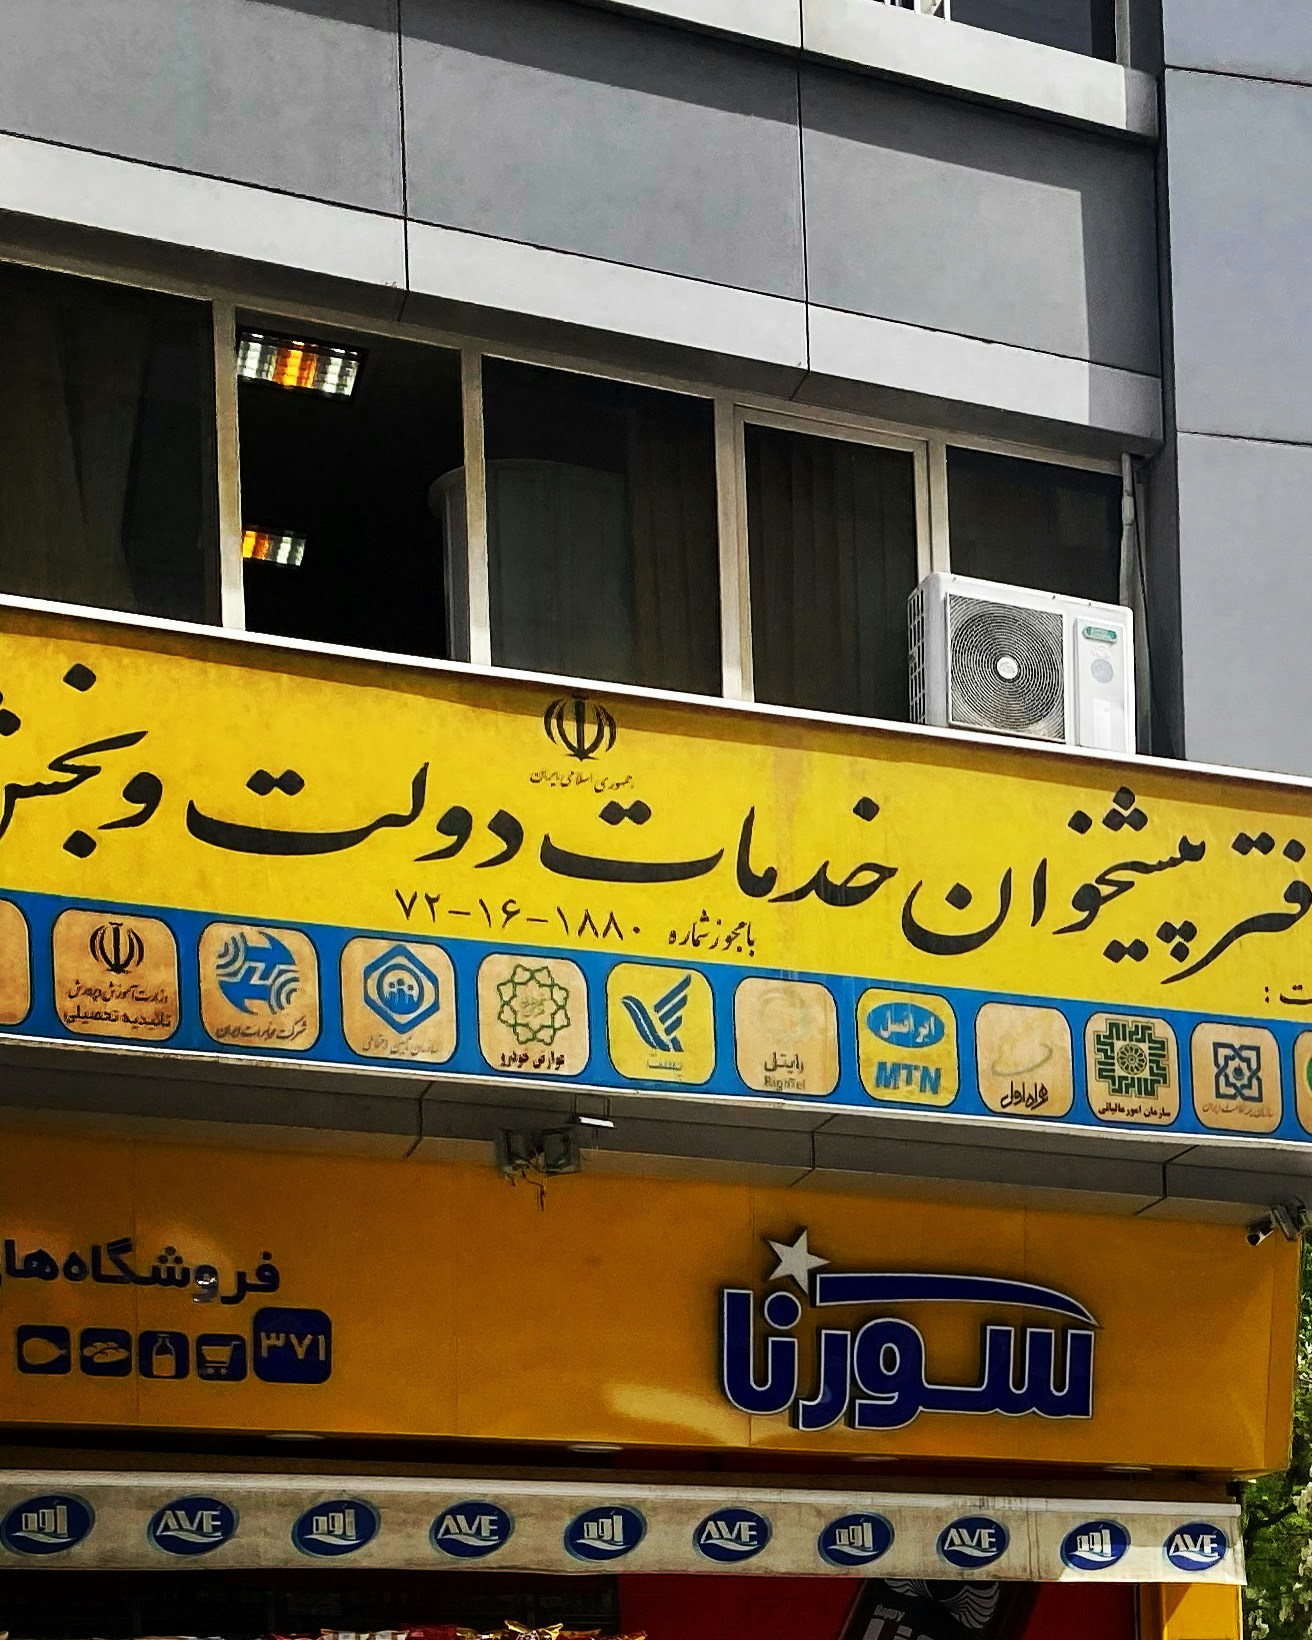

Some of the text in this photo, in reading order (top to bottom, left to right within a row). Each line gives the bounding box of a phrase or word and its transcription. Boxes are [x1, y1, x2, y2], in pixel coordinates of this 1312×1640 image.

[98, 771, 163, 831] و
[186, 761, 524, 869] دولت
[540, 796, 899, 907] خدمات
[901, 786, 1206, 963] پیشخوان
[667, 909, 710, 950] شماره
[63, 1004, 119, 1025] تحصیلی
[277, 1015, 307, 1041] شرکت
[879, 1009, 936, 1043] ایرانسل
[500, 1046, 530, 1068] خودرو
[763, 1051, 805, 1075] رایتل
[874, 1060, 942, 1096] MTN
[1000, 1080, 1049, 1112] همراه اول
[1097, 1102, 1172, 1120] سازمان امور مالیاتی
[259, 1331, 327, 1361] ۳۷۱
[720, 1286, 1097, 1432] سورنا
[156, 1509, 222, 1538] AVE
[437, 1514, 499, 1542] AVE
[700, 1519, 758, 1546] AVE
[943, 1527, 997, 1551] AVE
[1168, 1533, 1220, 1557] AVE
